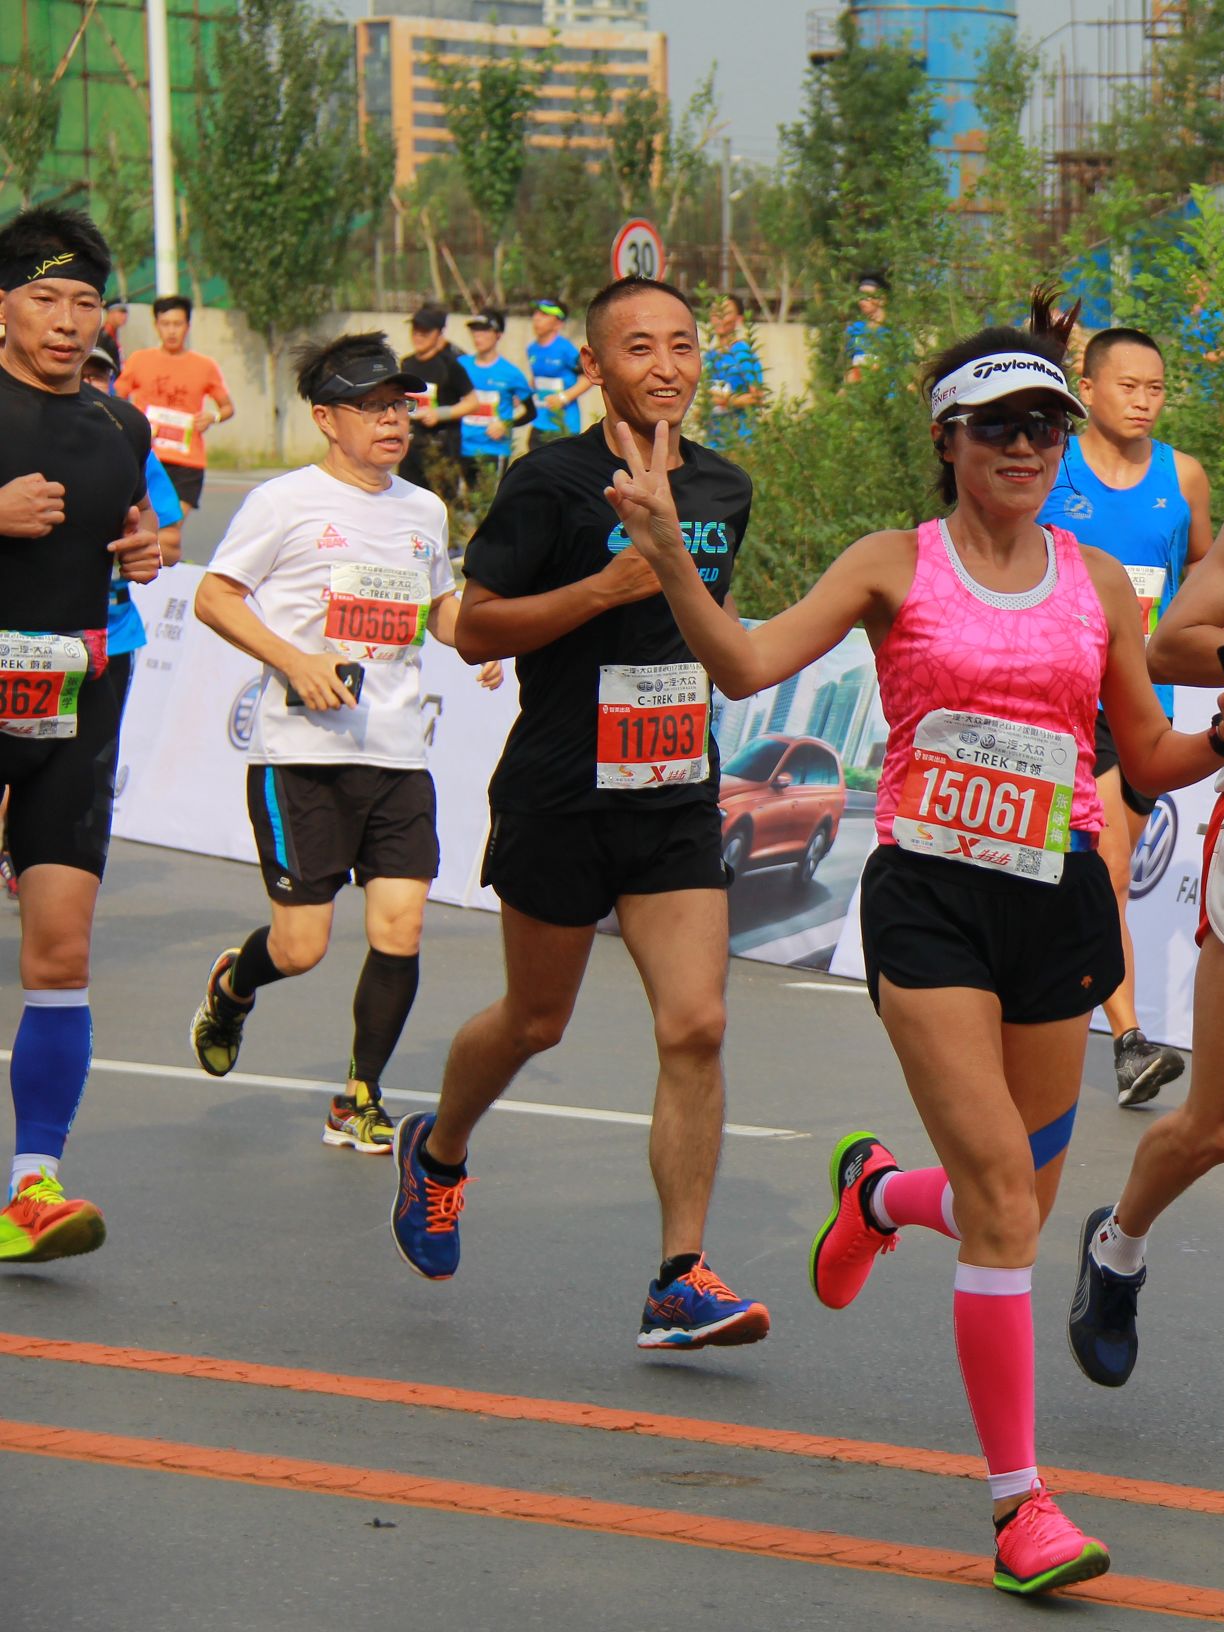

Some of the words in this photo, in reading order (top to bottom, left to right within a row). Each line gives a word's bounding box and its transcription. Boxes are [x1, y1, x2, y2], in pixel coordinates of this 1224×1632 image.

[628, 241, 654, 278] 30
[337, 604, 411, 643] 10565
[638, 694, 673, 706] C-TREK
[617, 713, 695, 759] 11793
[956, 747, 1009, 769] C-TREK
[1015, 760, 1042, 777] 蔚领
[918, 767, 1036, 840] 15061
